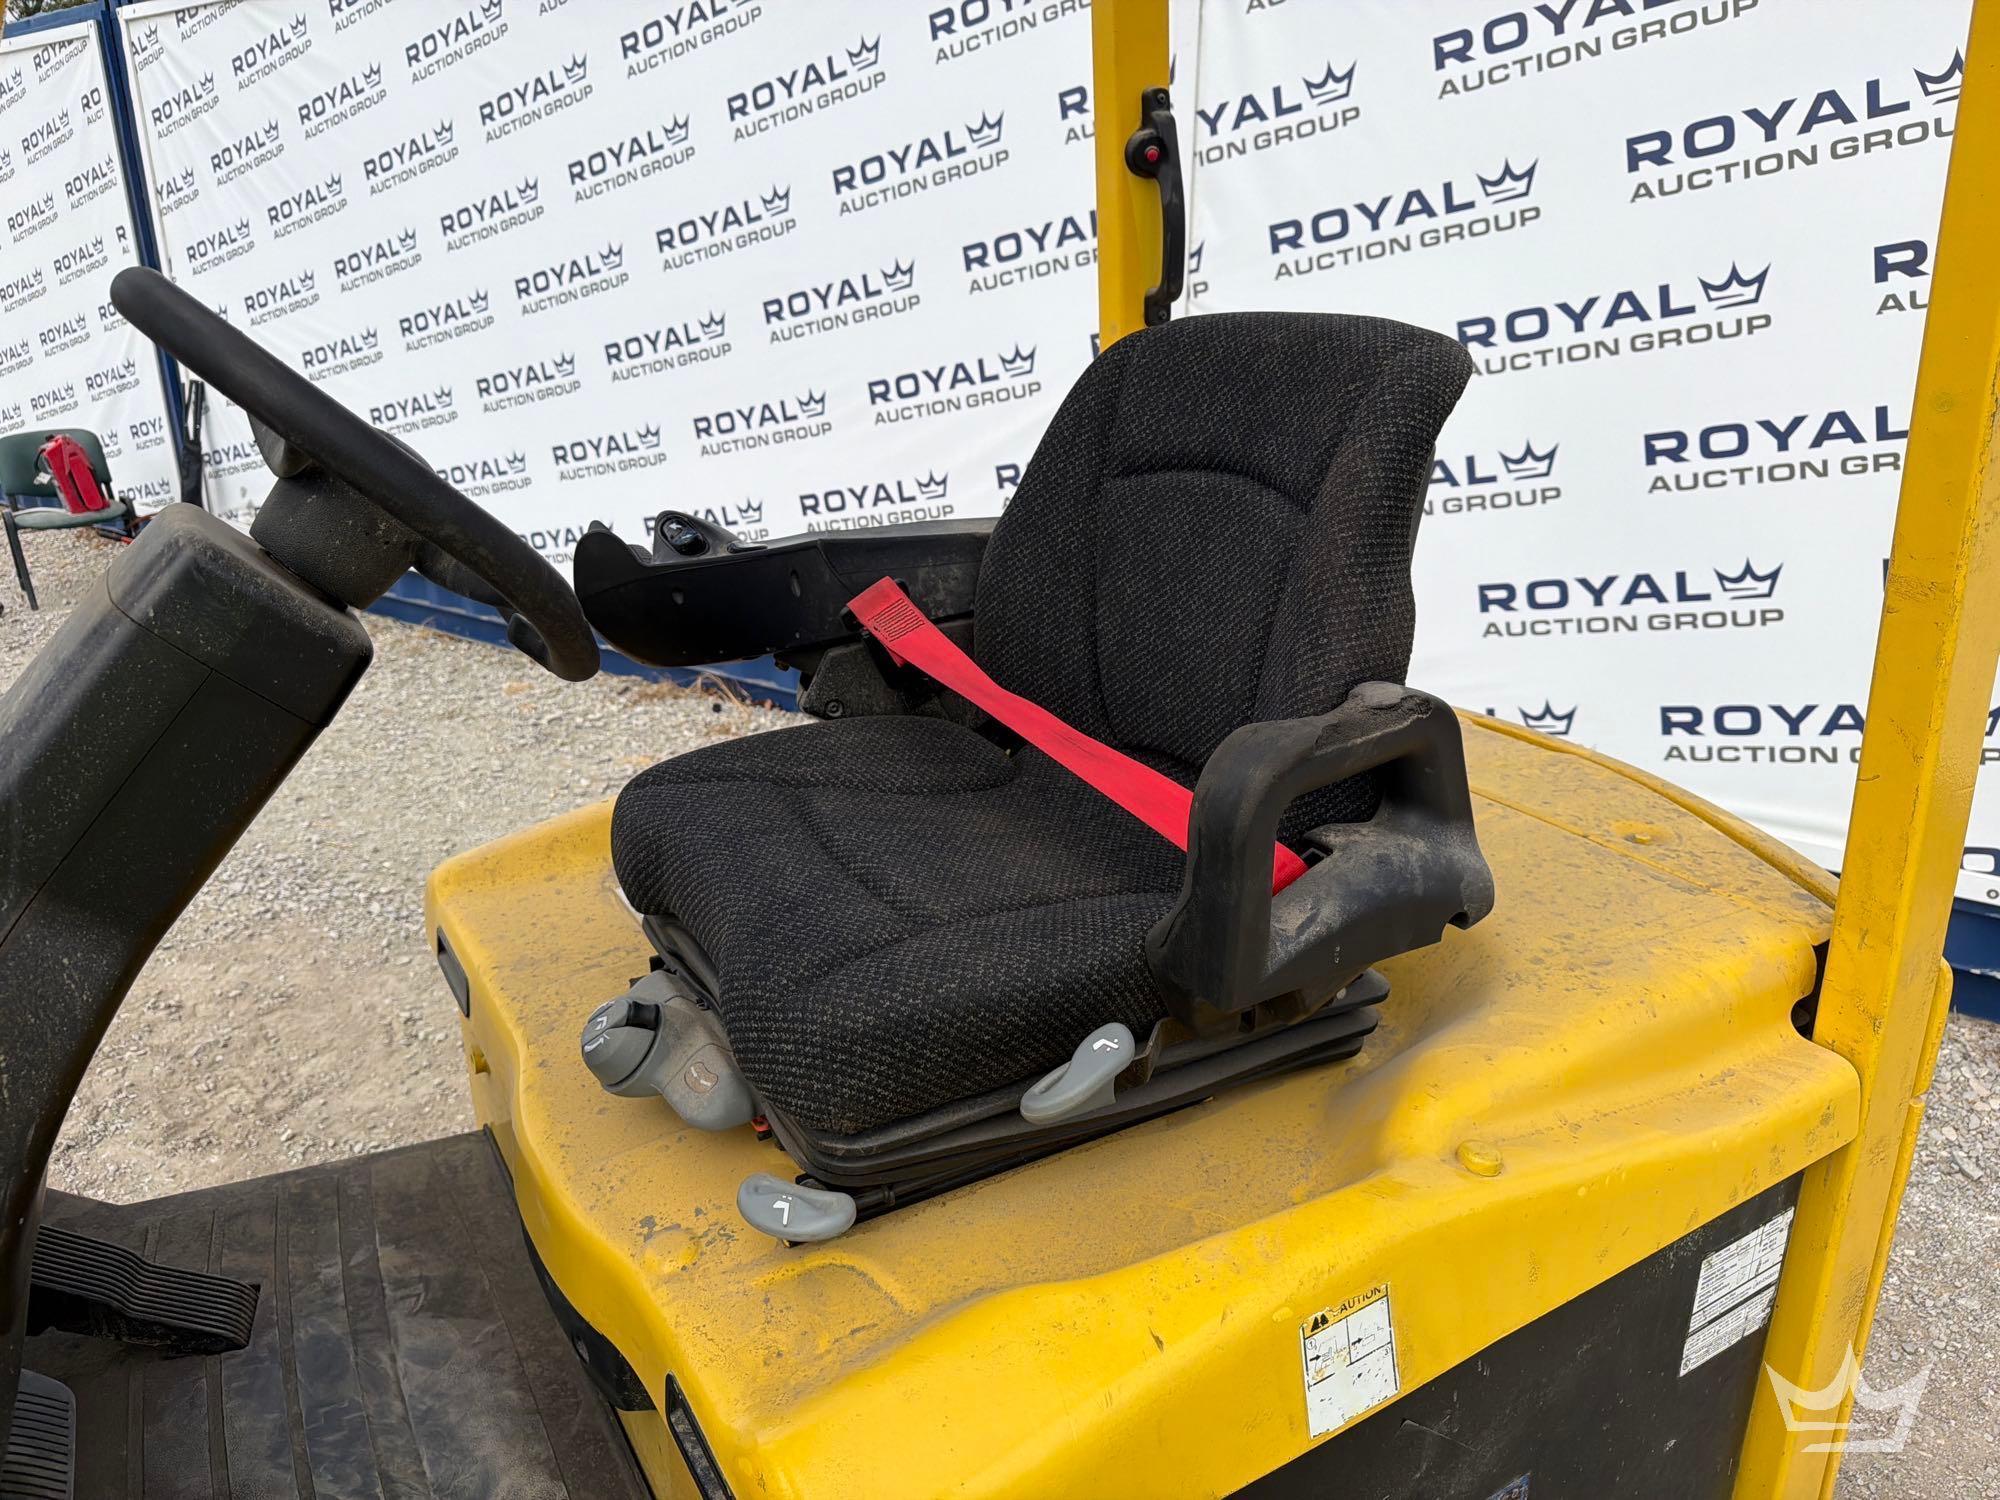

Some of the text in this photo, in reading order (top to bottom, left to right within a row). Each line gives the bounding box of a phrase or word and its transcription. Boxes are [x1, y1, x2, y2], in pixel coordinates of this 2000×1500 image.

[181, 10, 218, 42] AUCTION
[334, 0, 383, 34] AUCTION
[620, 0, 728, 60] ROYAL
[1433, 0, 1681, 71] ROYA
[33, 39, 74, 72] ROYA
[231, 27, 292, 77] ROYAL
[405, 10, 483, 68] ROYAL
[412, 22, 508, 84] AUCTION GROUP
[627, 6, 762, 78] AUCTION GROUP
[936, 12, 1037, 64] AUCTION
[1438, 0, 1760, 100] AUCTION GROUP
[39, 40, 88, 84] AUCTION GROUP
[138, 47, 164, 72] GROUP
[238, 38, 312, 91] AUCTION GROUP
[5, 87, 26, 108] GROUP
[151, 84, 203, 127] ROYAL
[297, 76, 365, 125] ROYAL
[478, 70, 565, 126] ROYAL
[727, 55, 847, 121] ROYAL
[734, 71, 886, 141] AUCTION GROUP
[158, 95, 220, 140] AUCTION GROUP
[304, 88, 387, 140] AUCTION GROUP
[486, 84, 593, 143] AUCTION GROUP
[1254, 106, 1360, 150] GROUP
[1626, 79, 1909, 173] ROYAL
[21, 117, 61, 154] ROYAL
[209, 131, 266, 173] ROYAL
[217, 143, 284, 187] AUCTION GROUP
[363, 133, 436, 180] ROYAL
[370, 146, 459, 196] AUCTION GROUP
[567, 130, 664, 185] ROYAL
[575, 146, 695, 203] AUCTION GROUP
[832, 130, 966, 195] ROYAL
[1631, 145, 1818, 202] AUCTION
[65, 162, 108, 199] ROYAL
[70, 187, 98, 212] AUCTION
[174, 188, 200, 210] GROUP
[839, 149, 1009, 215] AUCTION GROUP
[7, 200, 46, 233] ROYAL
[267, 184, 328, 226] ROYAL
[274, 198, 348, 239] AUCTION GROUP
[440, 190, 519, 236] ROYAL
[1269, 181, 1475, 254] ROYAL
[185, 227, 238, 263] ROYAL
[447, 205, 544, 252] AUCTION GROUP
[655, 200, 762, 253] ROYAL
[663, 218, 796, 271] AUCTION GROUP
[1275, 206, 1540, 279] AUCTION GROUP
[53, 243, 95, 275] ROYAL
[192, 240, 255, 276] AUCTION GROUP
[333, 238, 400, 279] ROYAL
[341, 253, 422, 293] AUCTION GROUP
[514, 255, 601, 299] ROYAL
[969, 256, 1069, 295] AUCTION
[0, 274, 35, 303] ROYAL
[243, 278, 301, 313] ROYAL
[522, 272, 629, 315] AUCTION GROUP
[762, 273, 882, 324] ROYAL
[250, 293, 320, 326] AUCTION GROUP
[398, 299, 471, 337] ROYAL
[770, 294, 920, 343] AUCTION GROUP
[1456, 284, 1696, 352] ROYAL
[38, 319, 78, 347] ROYAL
[301, 335, 363, 369] ROYAL
[406, 315, 495, 352] AUCTION GROUP
[604, 323, 701, 365] ROYAL
[1629, 314, 1771, 353] GROUP
[85, 365, 126, 391] ROYAL
[309, 351, 384, 382] AUCTION GROUP
[475, 361, 555, 398] ROYAL
[612, 342, 732, 382] AUCTION GROUP
[867, 358, 999, 405] ROYAL
[29, 387, 66, 412] ROYAL
[369, 393, 437, 426] ROYAL
[483, 380, 581, 413] AUCTION GROUP
[875, 381, 1041, 424] AUCTION GROUP
[421, 410, 458, 429] GROUP
[693, 400, 798, 439] ROYAL
[700, 422, 832, 456] AUCTION GROUP
[1644, 405, 1908, 466] ROYAL
[202, 442, 251, 466] ROYAL
[551, 432, 639, 465] ROYAL
[559, 452, 667, 481] AUCTION GROUP
[491, 476, 532, 493] GROUP
[1648, 459, 1828, 494] AUCTION
[799, 480, 917, 516] ROYAL
[807, 504, 954, 532] AUCTION GROUP
[1442, 486, 1561, 514] GROUP
[1479, 571, 1711, 613] ROYAL
[1484, 608, 1784, 637] AUCTION GROUP
[1664, 746, 1838, 764] AUCTION
[1333, 1287, 1381, 1317] AUTION
